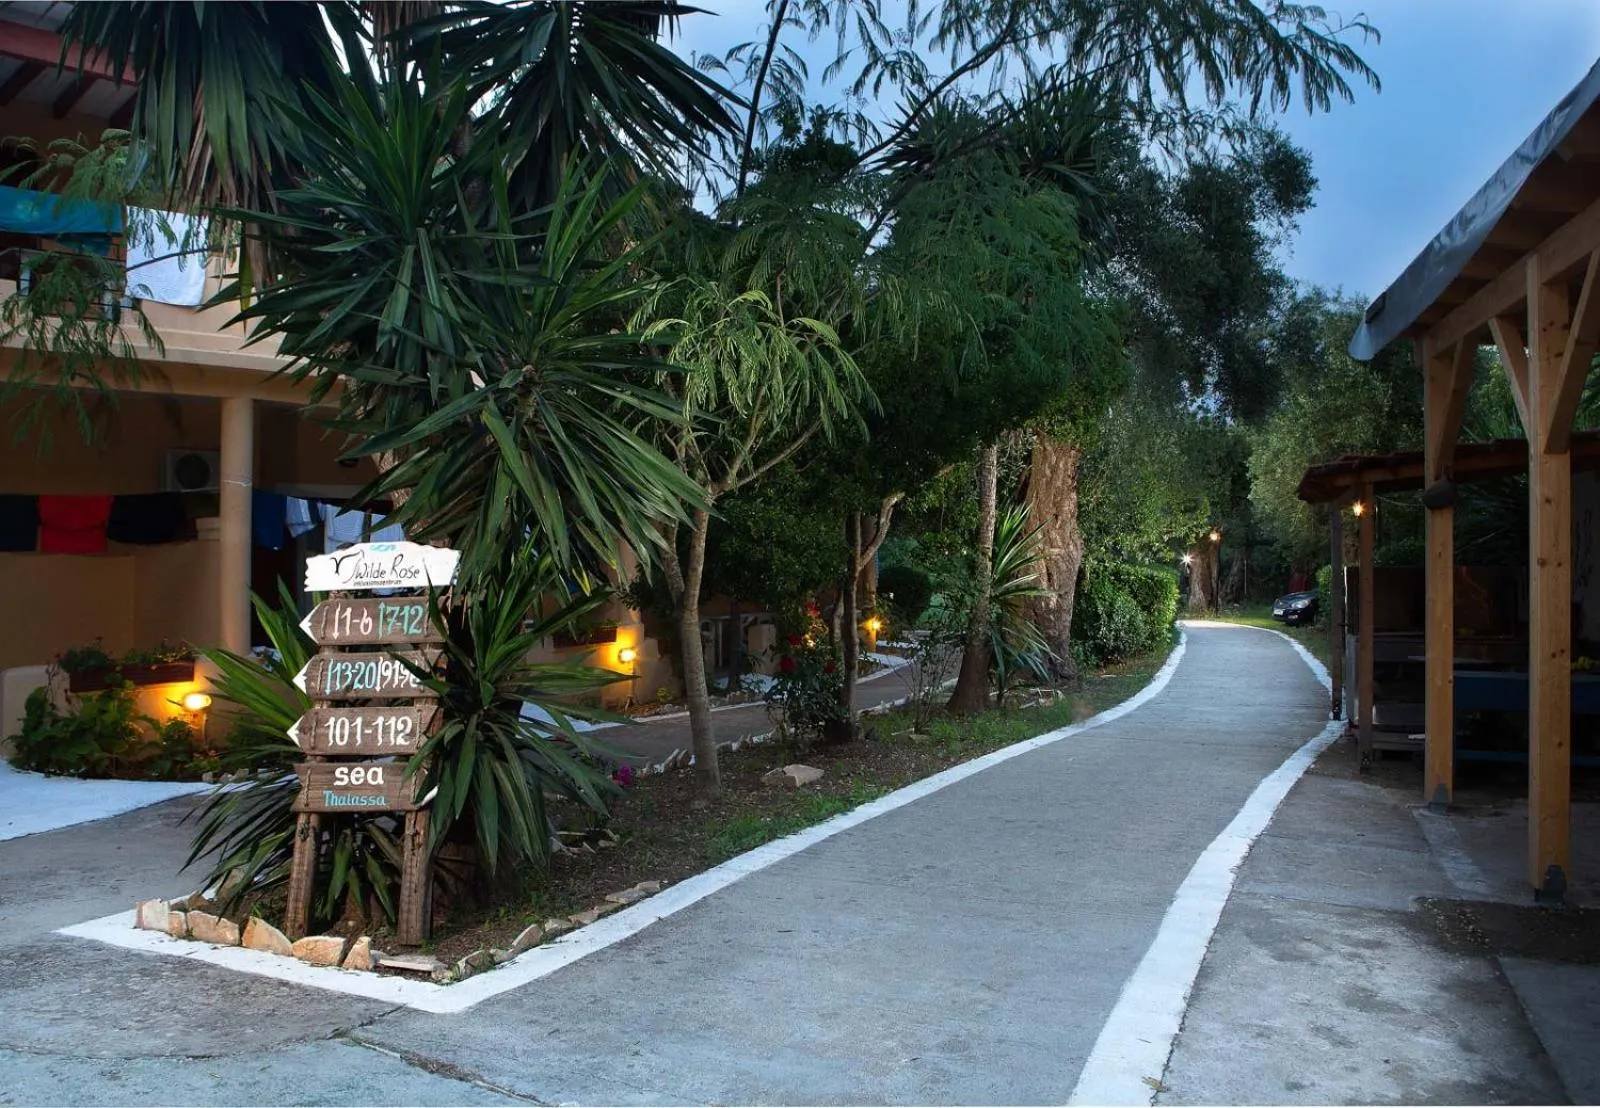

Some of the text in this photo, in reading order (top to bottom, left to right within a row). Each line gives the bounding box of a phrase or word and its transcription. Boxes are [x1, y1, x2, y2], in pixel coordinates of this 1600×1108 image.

[355, 553, 420, 579] Wilde Rose
[341, 605, 424, 635] 1-6 7-12
[332, 661, 376, 690] 13-20
[324, 716, 413, 746] 101-112
[333, 766, 384, 786] sea
[323, 790, 387, 807] Thalassa
